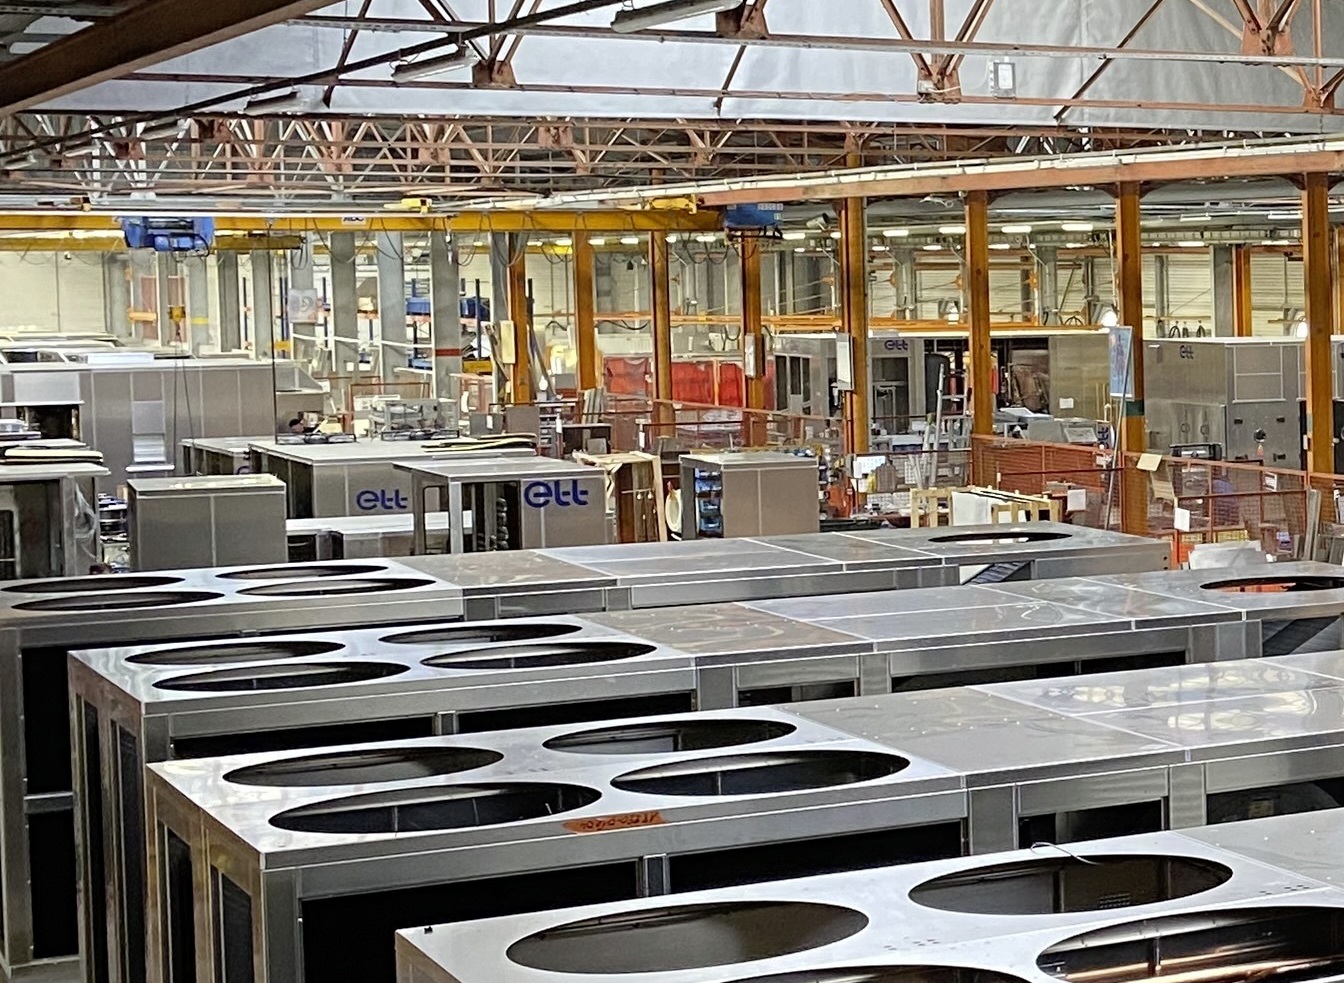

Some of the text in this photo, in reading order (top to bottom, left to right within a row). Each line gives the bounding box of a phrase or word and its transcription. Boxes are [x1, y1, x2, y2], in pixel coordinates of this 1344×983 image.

[884, 339, 908, 351] ett
[1179, 345, 1194, 359] ett
[356, 489, 408, 510] ett
[524, 479, 588, 508] ett
